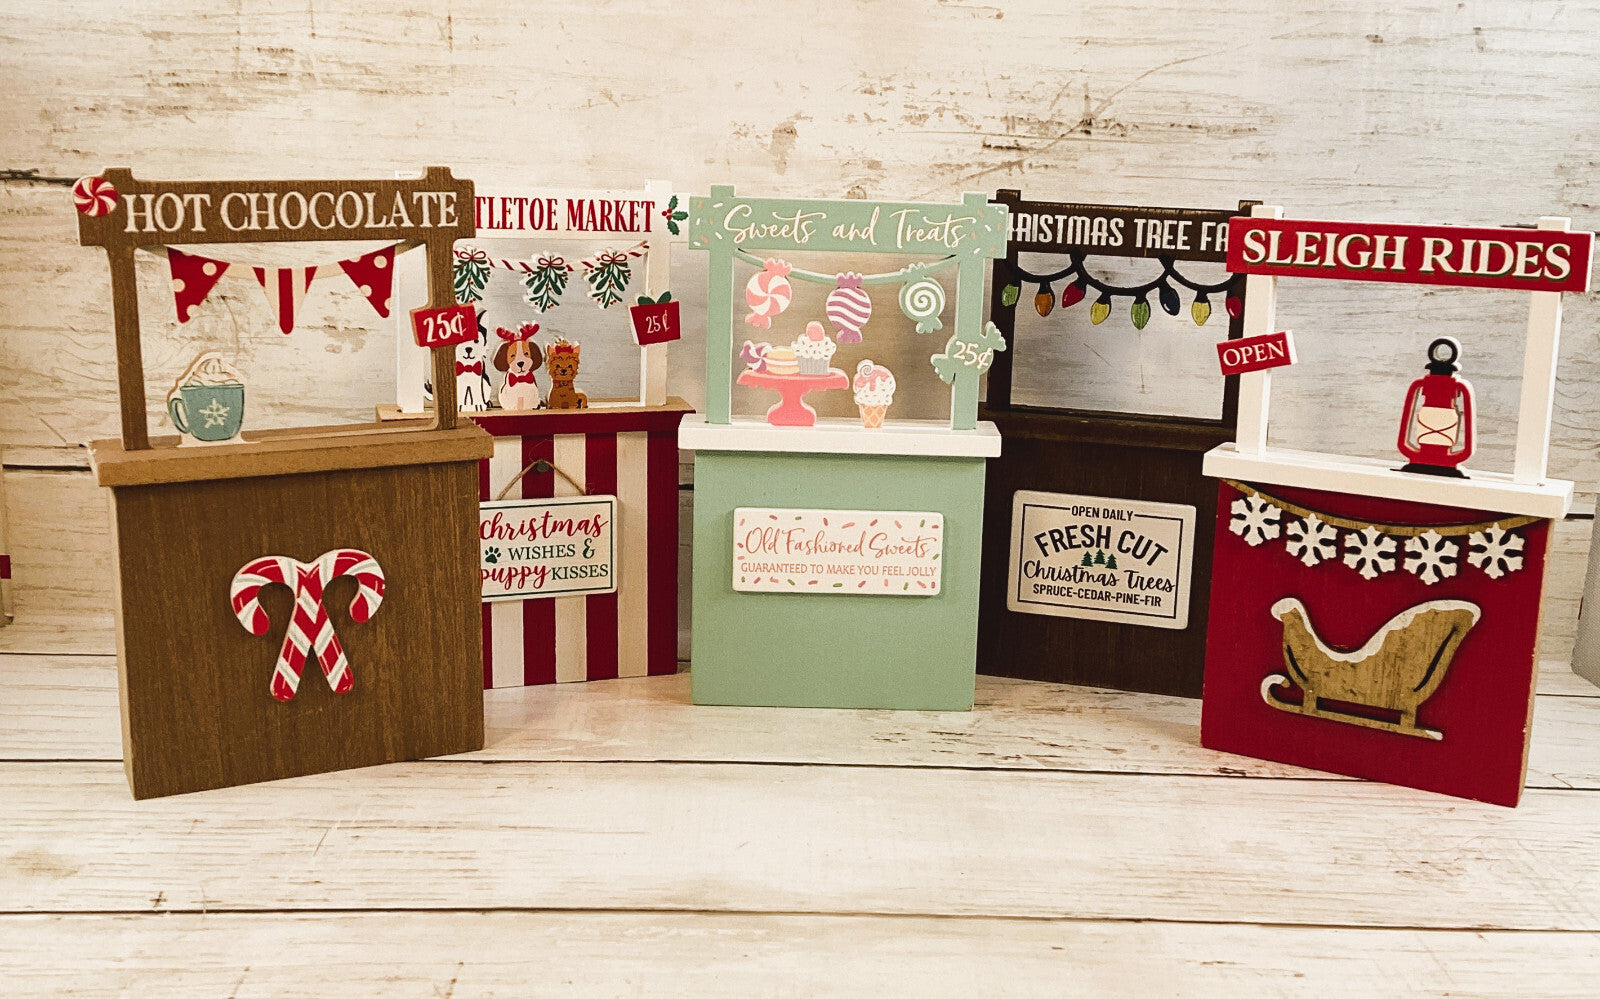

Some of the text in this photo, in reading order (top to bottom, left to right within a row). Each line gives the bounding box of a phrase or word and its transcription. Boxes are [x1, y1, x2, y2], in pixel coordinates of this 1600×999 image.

[122, 190, 459, 233] HOT CHOCOLATE
[565, 198, 656, 234] MARKET
[723, 203, 977, 249] Sweets and Treats
[1133, 218, 1191, 251] TREE
[1242, 229, 1572, 282] SLEIGH RIDES
[423, 311, 468, 344] 25¢
[645, 309, 671, 335] 25¢
[953, 340, 993, 370] 25¢
[1222, 340, 1286, 367] OPEN
[1071, 505, 1134, 522] OPEN DAILY
[508, 537, 596, 561] WISHES &
[745, 527, 938, 559] Old Fashioned Sweets
[1034, 524, 1169, 567] FRESH CUT
[551, 563, 609, 581] KISSES
[741, 562, 937, 577] GUARANTEED TO MAKE YOU FEEL JOLLY
[1023, 559, 1176, 593] Christmas Trees
[1033, 583, 1162, 607] SPRUCE-CEDAR-PINE-FIR
